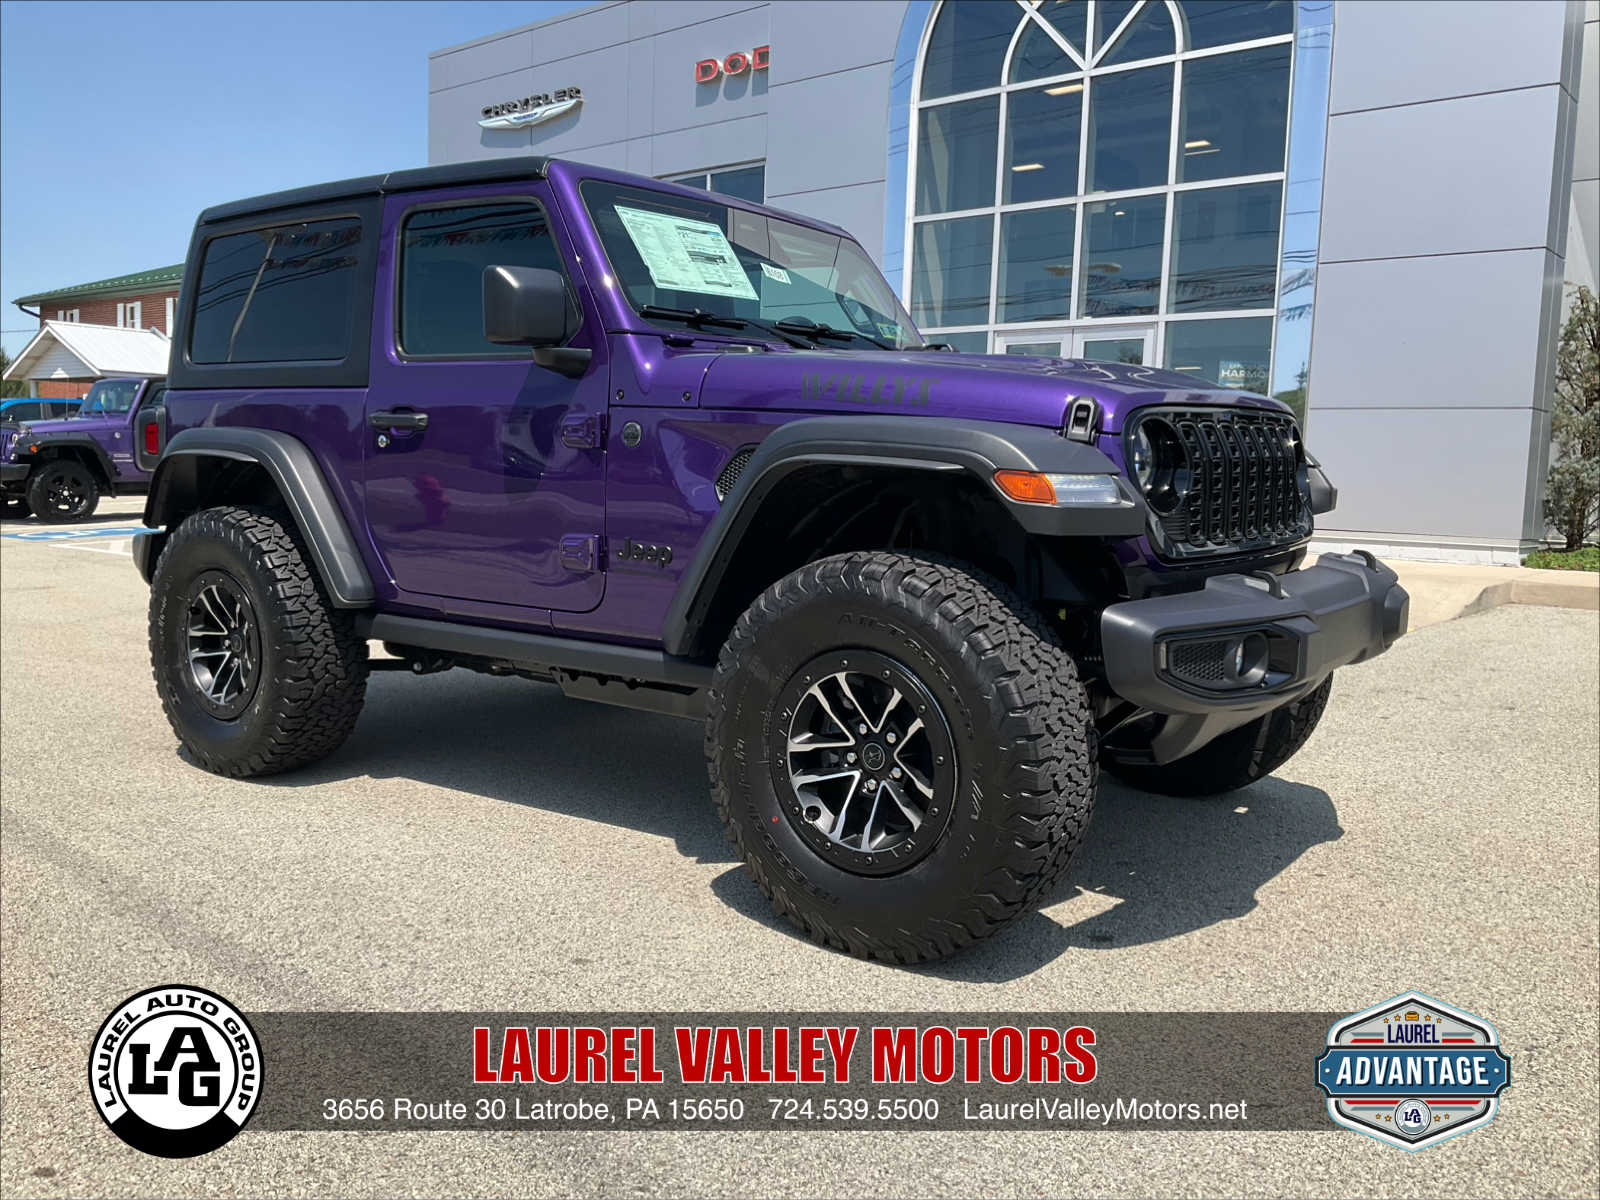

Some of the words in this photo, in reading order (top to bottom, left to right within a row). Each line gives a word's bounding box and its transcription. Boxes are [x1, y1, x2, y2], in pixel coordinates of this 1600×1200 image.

[480, 86, 582, 120] CHRYSLER
[802, 369, 941, 407] WILLYS
[616, 537, 673, 569] Jeep
